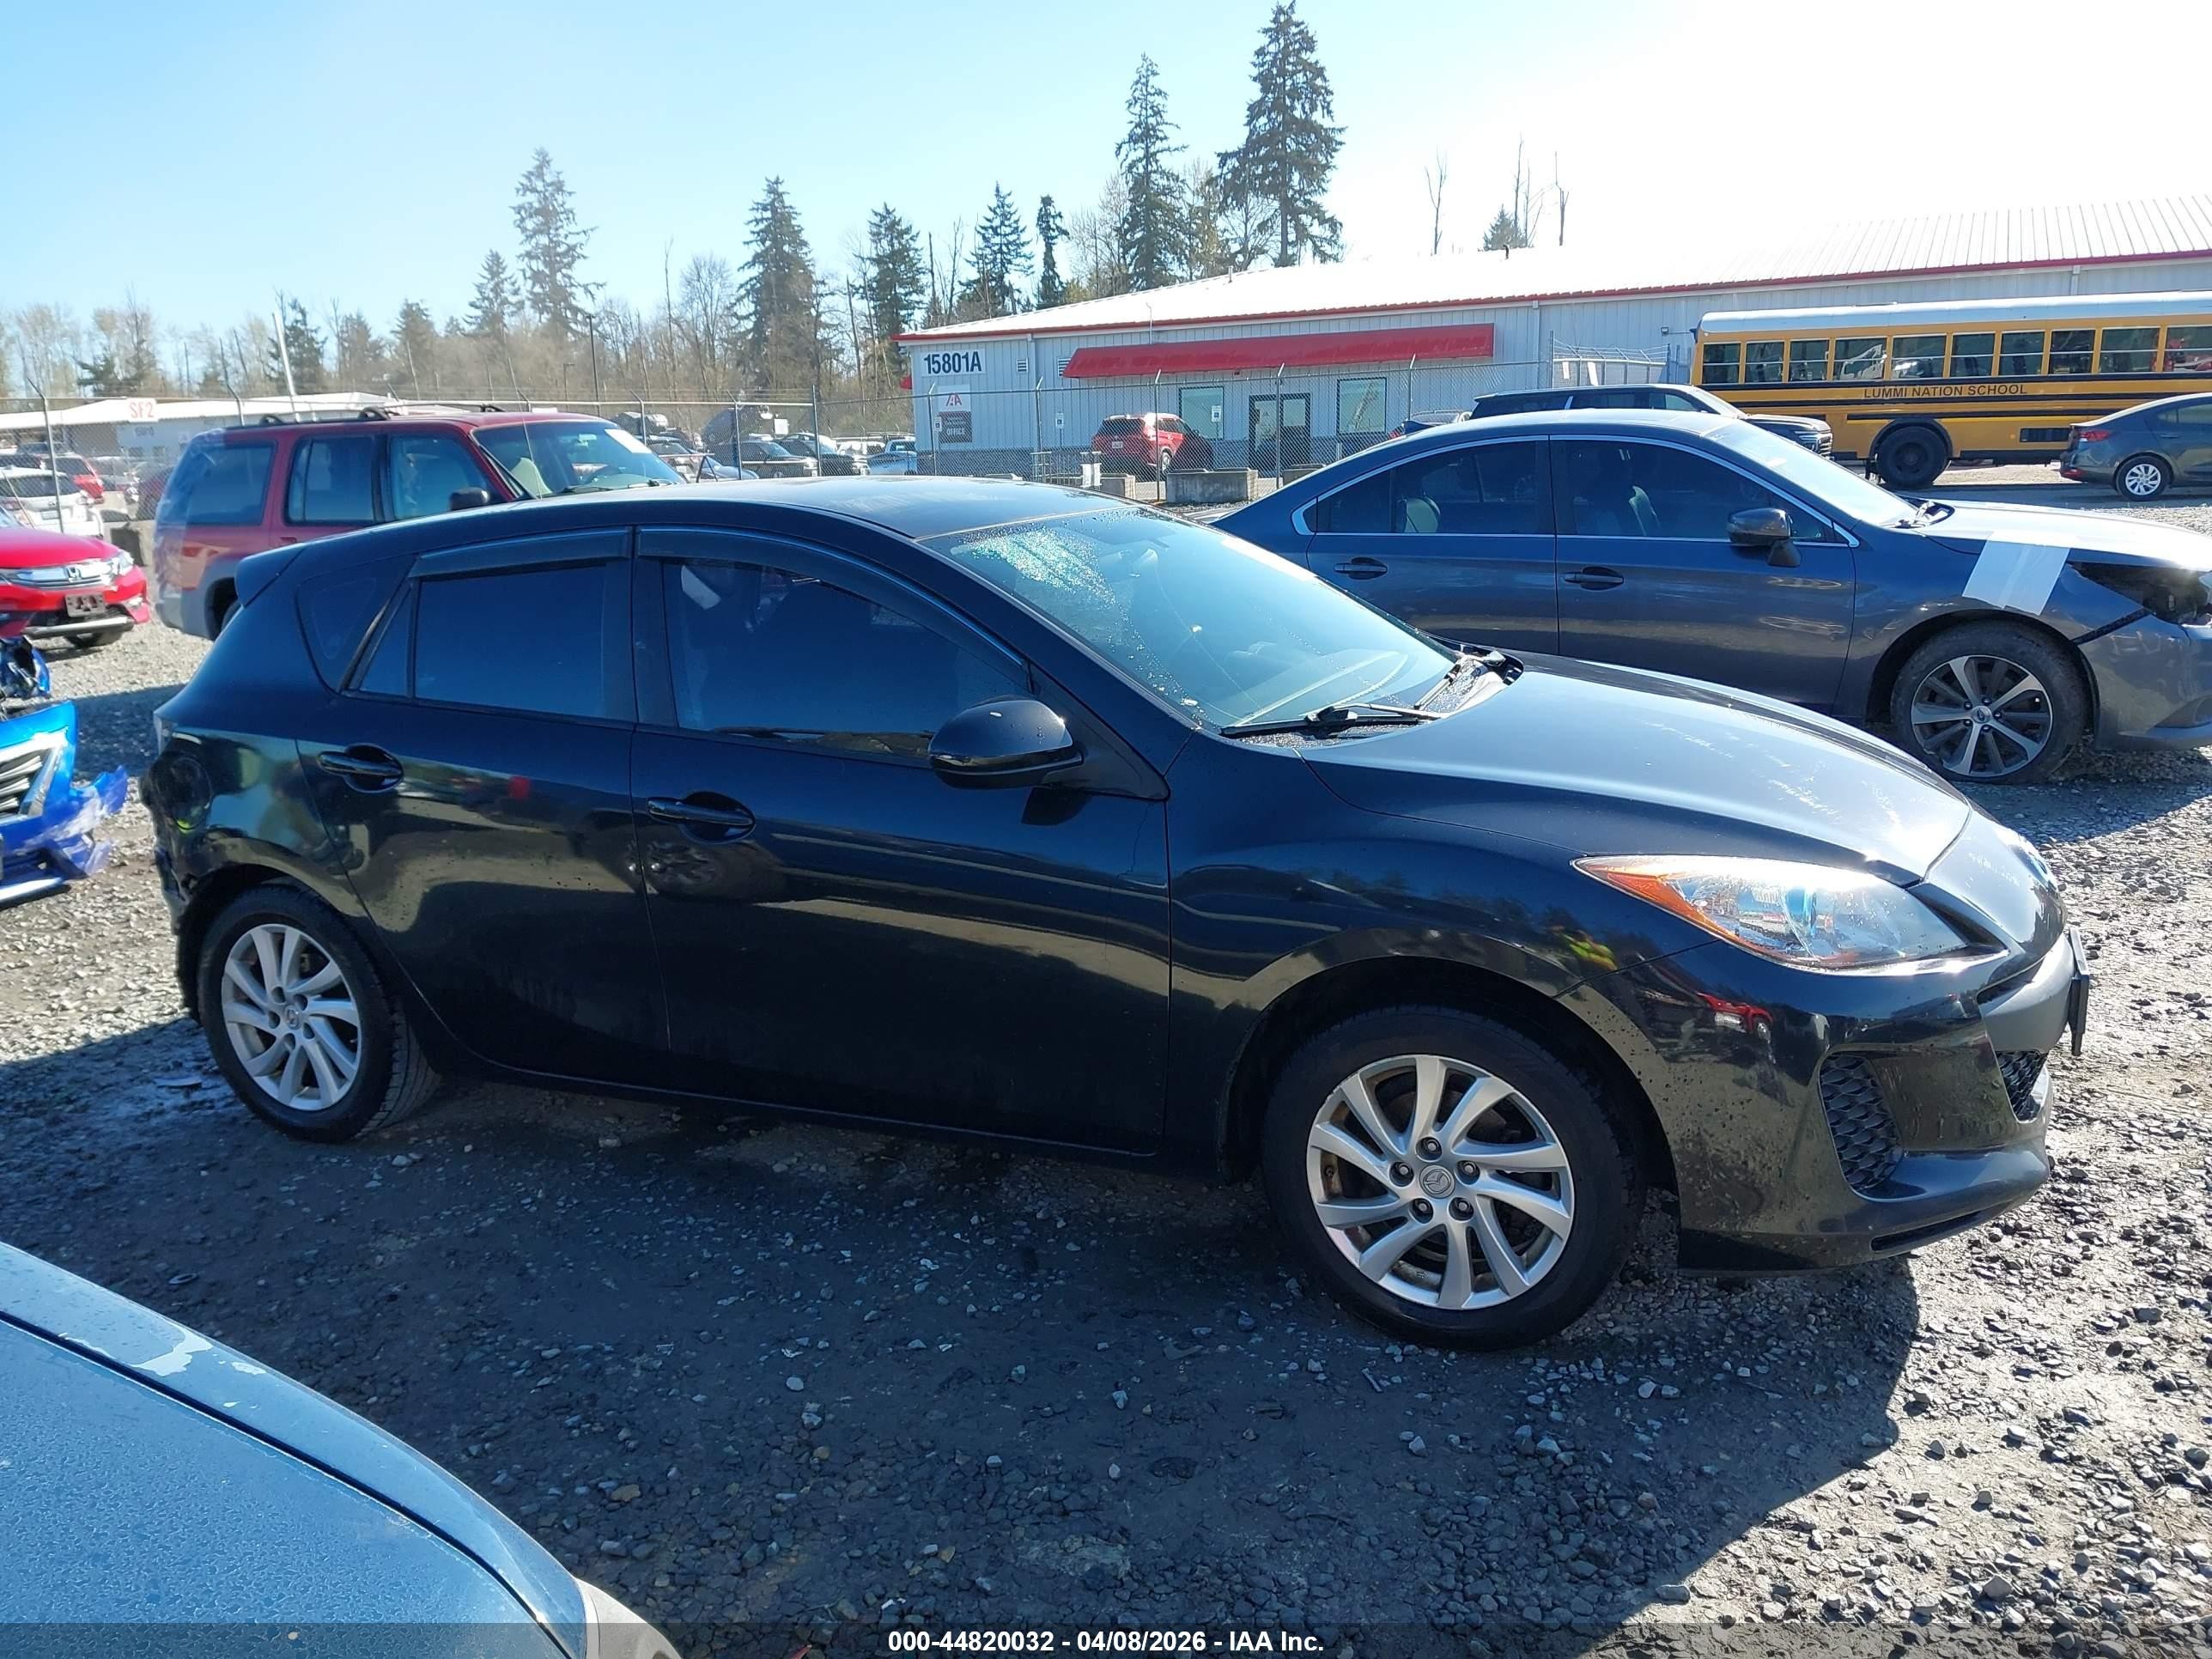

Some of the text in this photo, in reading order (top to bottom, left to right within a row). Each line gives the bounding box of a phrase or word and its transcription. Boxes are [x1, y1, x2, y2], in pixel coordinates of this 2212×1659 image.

[924, 351, 981, 374] 15801A
[1864, 384, 2028, 398] LUMMI NATION SCHOOL
